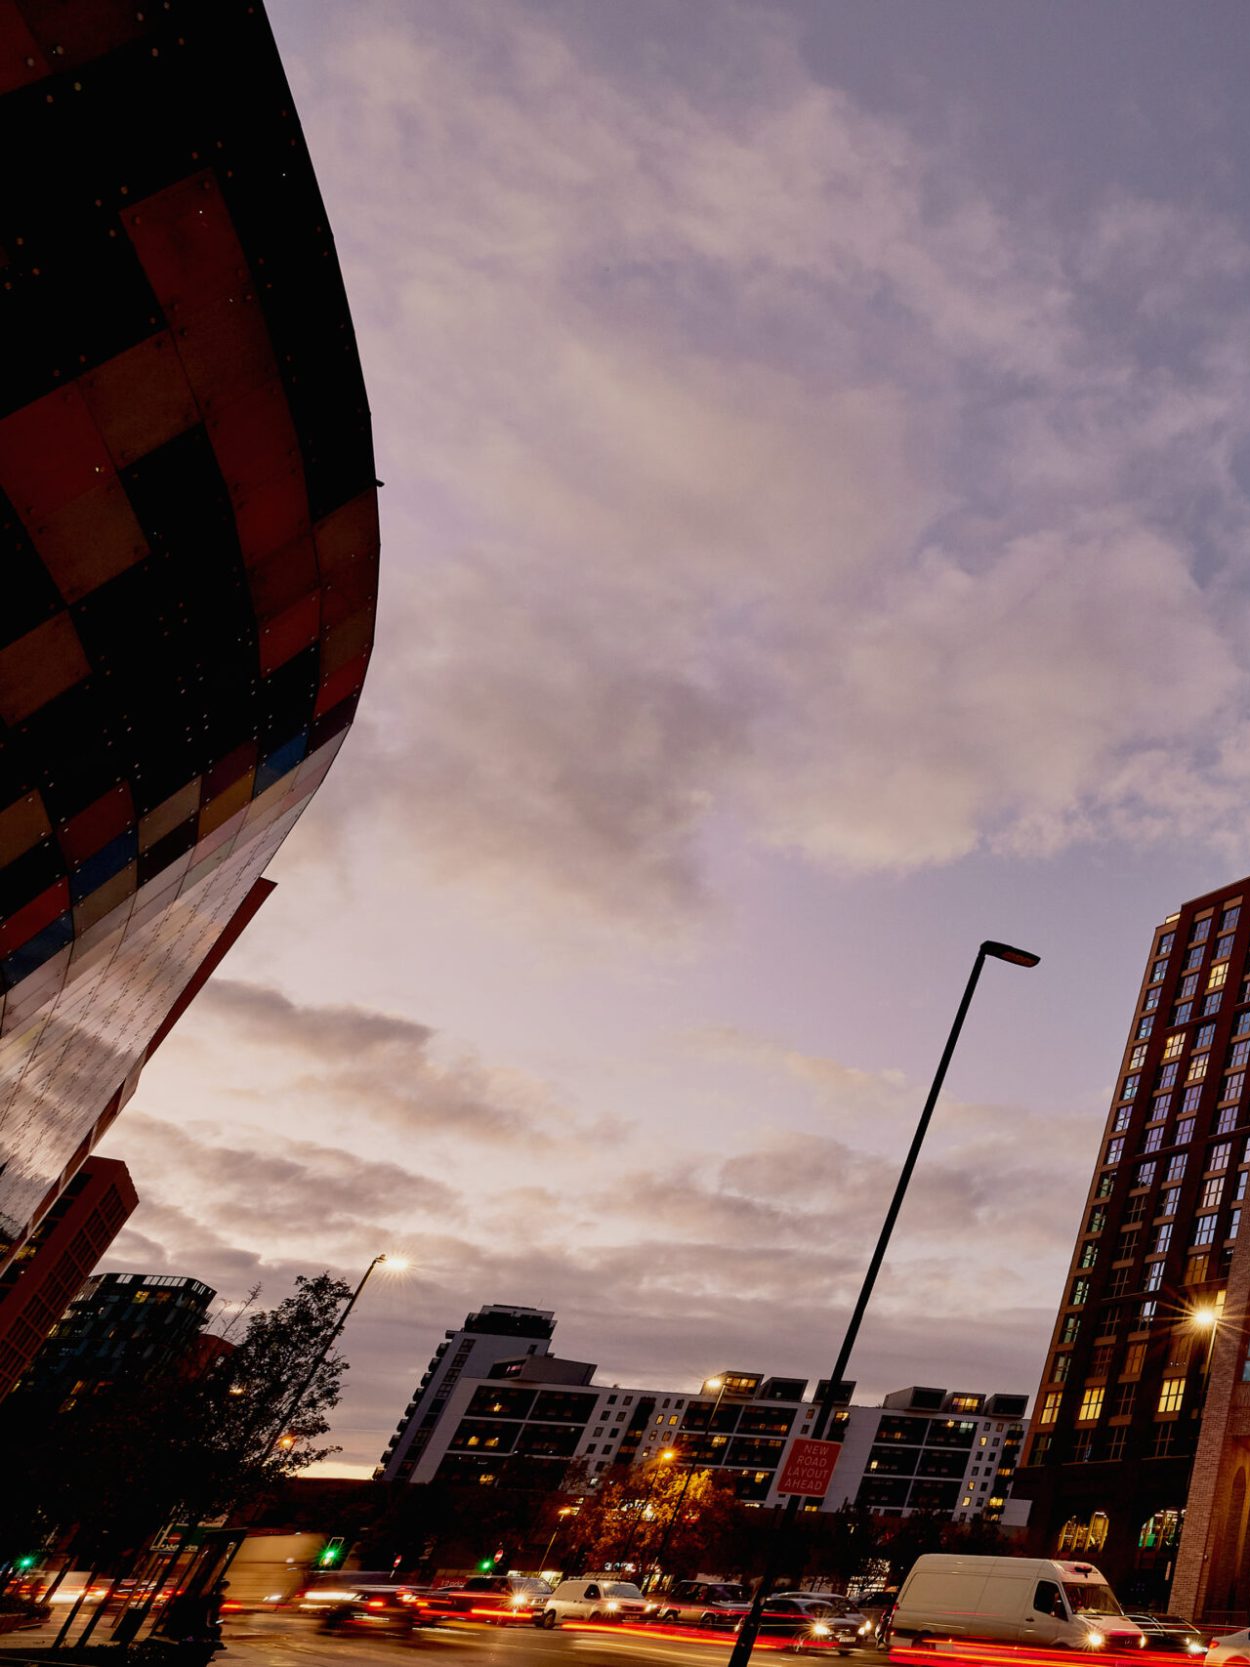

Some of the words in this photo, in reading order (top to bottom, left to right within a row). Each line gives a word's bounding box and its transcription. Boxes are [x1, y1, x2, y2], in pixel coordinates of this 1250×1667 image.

[803, 1444, 829, 1455] NEW
[796, 1455, 827, 1467] ROAD
[787, 1466, 829, 1479] LAYOUT
[784, 1478, 822, 1490] AHEAD
